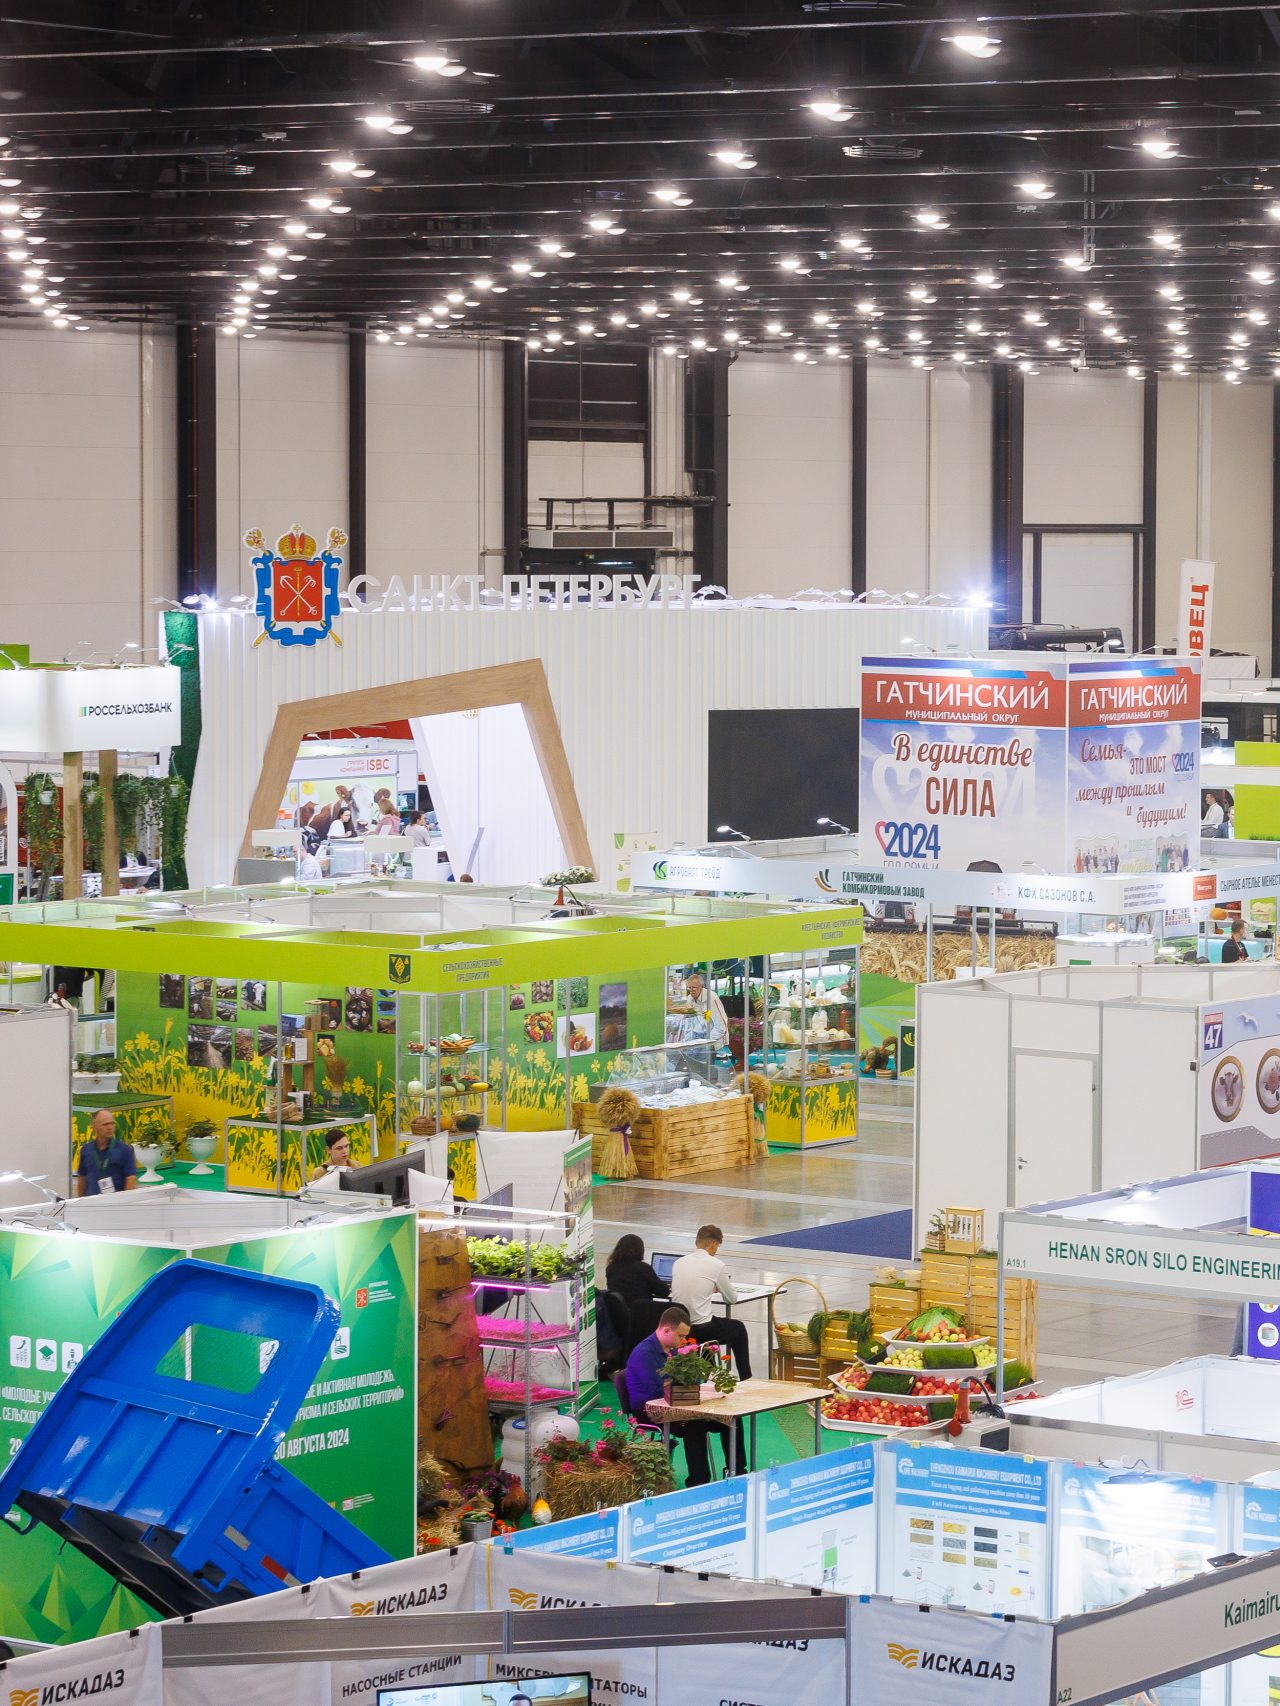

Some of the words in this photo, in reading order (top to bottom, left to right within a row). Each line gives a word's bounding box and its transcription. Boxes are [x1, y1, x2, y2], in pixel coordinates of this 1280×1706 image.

[1189, 584, 1209, 656] ВЕЦ
[876, 680, 1049, 709] ГАТЧИНСКИЙ
[1081, 678, 1188, 711] ГАТЧИНСКИЙ
[88, 702, 173, 716] РОССЕЛЬХОЗБАНК
[906, 710, 987, 722] МУНИЦИПАЛЬНЫЙ
[992, 713, 1019, 724] ОКРУГ
[1099, 709, 1151, 722] МУНИЦИПАЛЬНЫЙ
[893, 733, 911, 762] В
[917, 738, 1032, 771] единстве
[1174, 752, 1195, 772] 2024
[366, 759, 390, 771] ISBC
[1130, 757, 1144, 775] ЭТО
[1146, 755, 1167, 774] МОСТ
[926, 776, 996, 817] СИЛА
[1076, 785, 1113, 805] между
[1115, 782, 1165, 803] прошлым
[1136, 803, 1187, 828] будущим!
[884, 821, 941, 860] 2024
[842, 871, 884, 883] ГАТЧИНСКИЙ
[1220, 879, 1241, 892] СЫРНОЕ
[1242, 876, 1261, 889] АТЕЛЬЕ
[842, 883, 901, 896] КОМБИКОРМОВЫЙ
[902, 886, 925, 899] ЗАВОД
[1018, 887, 1036, 900] КФХ
[1039, 888, 1078, 902] САЗОНОВ
[1205, 1024, 1222, 1048] 47
[1006, 1258, 1027, 1268] A19.1
[1048, 1240, 1100, 1262] HENAN
[1105, 1246, 1148, 1267] SRON
[1152, 1251, 1187, 1271] SILO
[323, 1375, 356, 1394] АКТИВНАЯ
[328, 1398, 361, 1415] СЕЛЬСКИХ
[287, 1432, 326, 1458] АВГУСТА
[327, 1428, 350, 1449] 2024
[376, 1583, 448, 1616] ИСКАДАЗ
[342, 1669, 405, 1698] НАСОСНЫЕ
[408, 1654, 462, 1680] СТАНЦИИ
[921, 1651, 1015, 1682] ИСКАДАЗ
[41, 1669, 125, 1706] ИСКАДАЗ
[1058, 1688, 1072, 1704] A22
